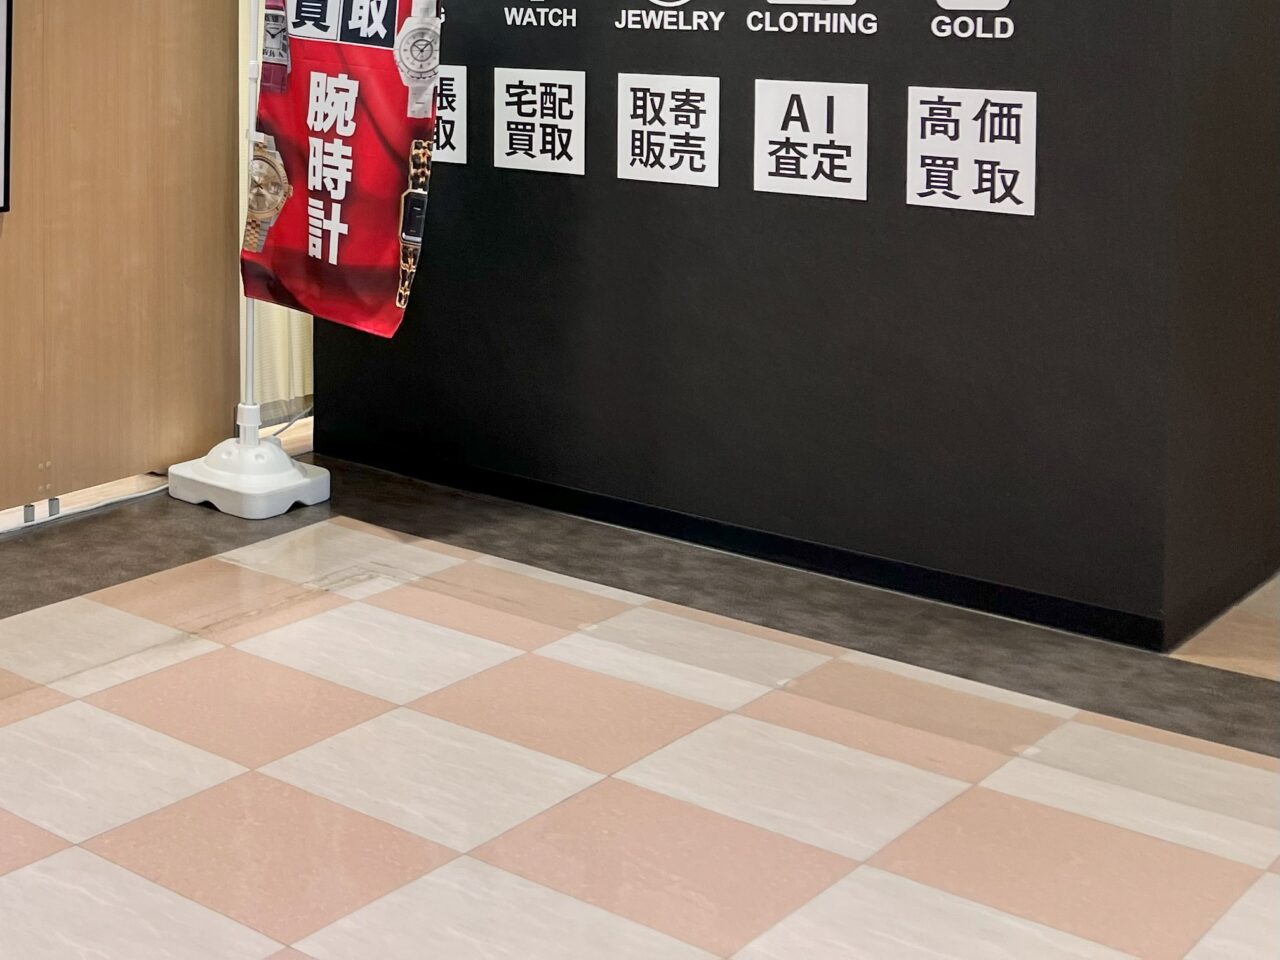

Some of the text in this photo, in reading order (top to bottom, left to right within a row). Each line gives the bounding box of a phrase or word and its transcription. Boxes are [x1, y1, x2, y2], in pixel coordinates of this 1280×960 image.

[504, 6, 577, 28] WATCH
[614, 9, 726, 32] JEWELRY
[746, 10, 878, 34] CLOTHING
[930, 15, 1015, 39] GOLD
[436, 77, 456, 113] 張
[505, 80, 574, 120] 宅配
[630, 86, 707, 129] 取寄
[780, 93, 835, 134] AI
[434, 116, 456, 152] 取
[919, 95, 1024, 144] 高価
[505, 121, 574, 162] 買取
[630, 130, 707, 173] 販売
[767, 136, 853, 183] 査定
[306, 71, 359, 266] 腕時計
[916, 155, 1024, 206] 買取
